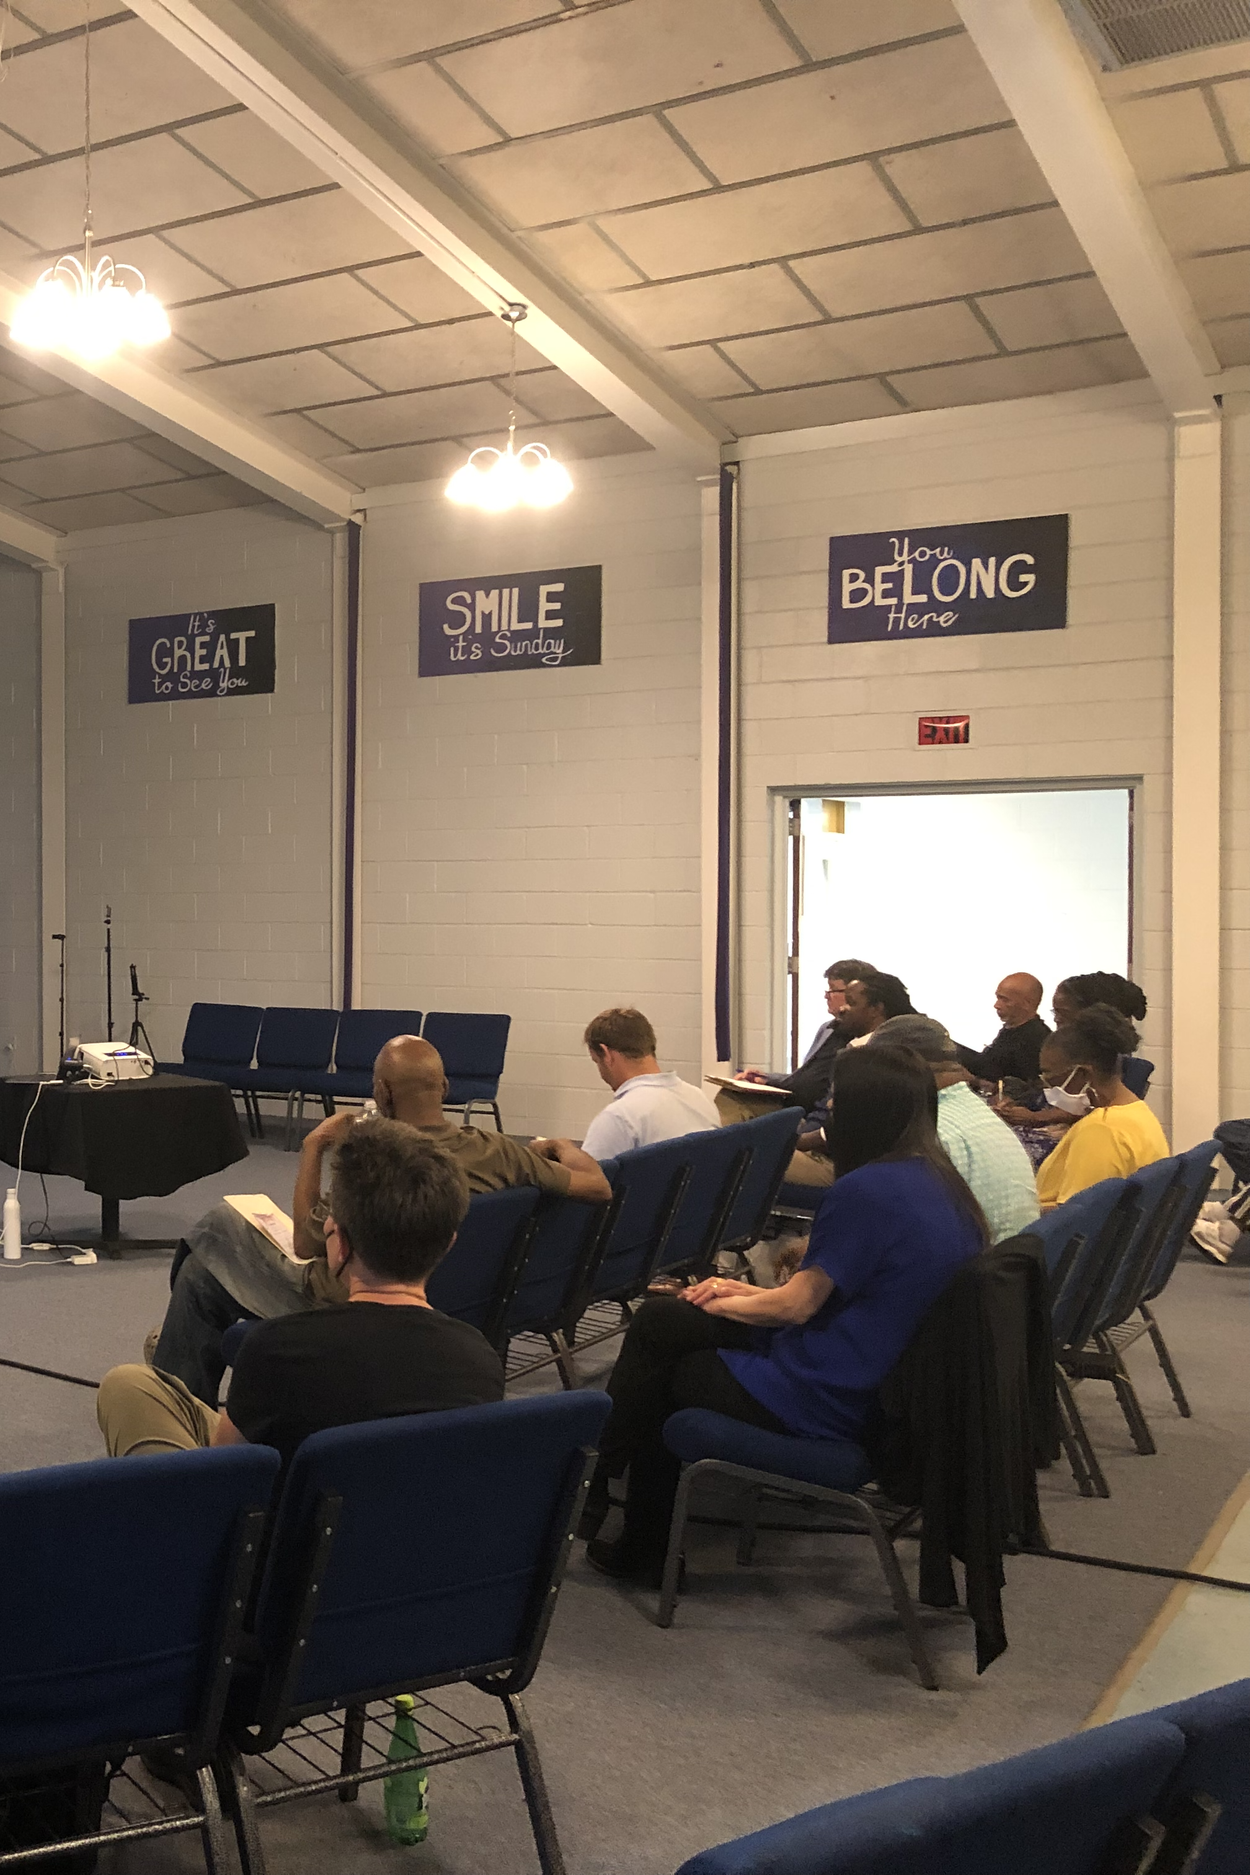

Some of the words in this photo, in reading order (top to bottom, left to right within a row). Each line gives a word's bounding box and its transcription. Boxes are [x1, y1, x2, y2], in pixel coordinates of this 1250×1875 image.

[888, 537, 954, 571] You
[841, 553, 1036, 609] BELONG
[187, 612, 217, 635] It's
[442, 582, 565, 636] SMILE
[887, 604, 960, 632] Here
[151, 630, 256, 675] GREAT
[449, 634, 483, 661] it's
[490, 629, 573, 665] Sunday
[151, 673, 174, 694] to
[178, 670, 213, 692] See
[216, 667, 249, 696] You
